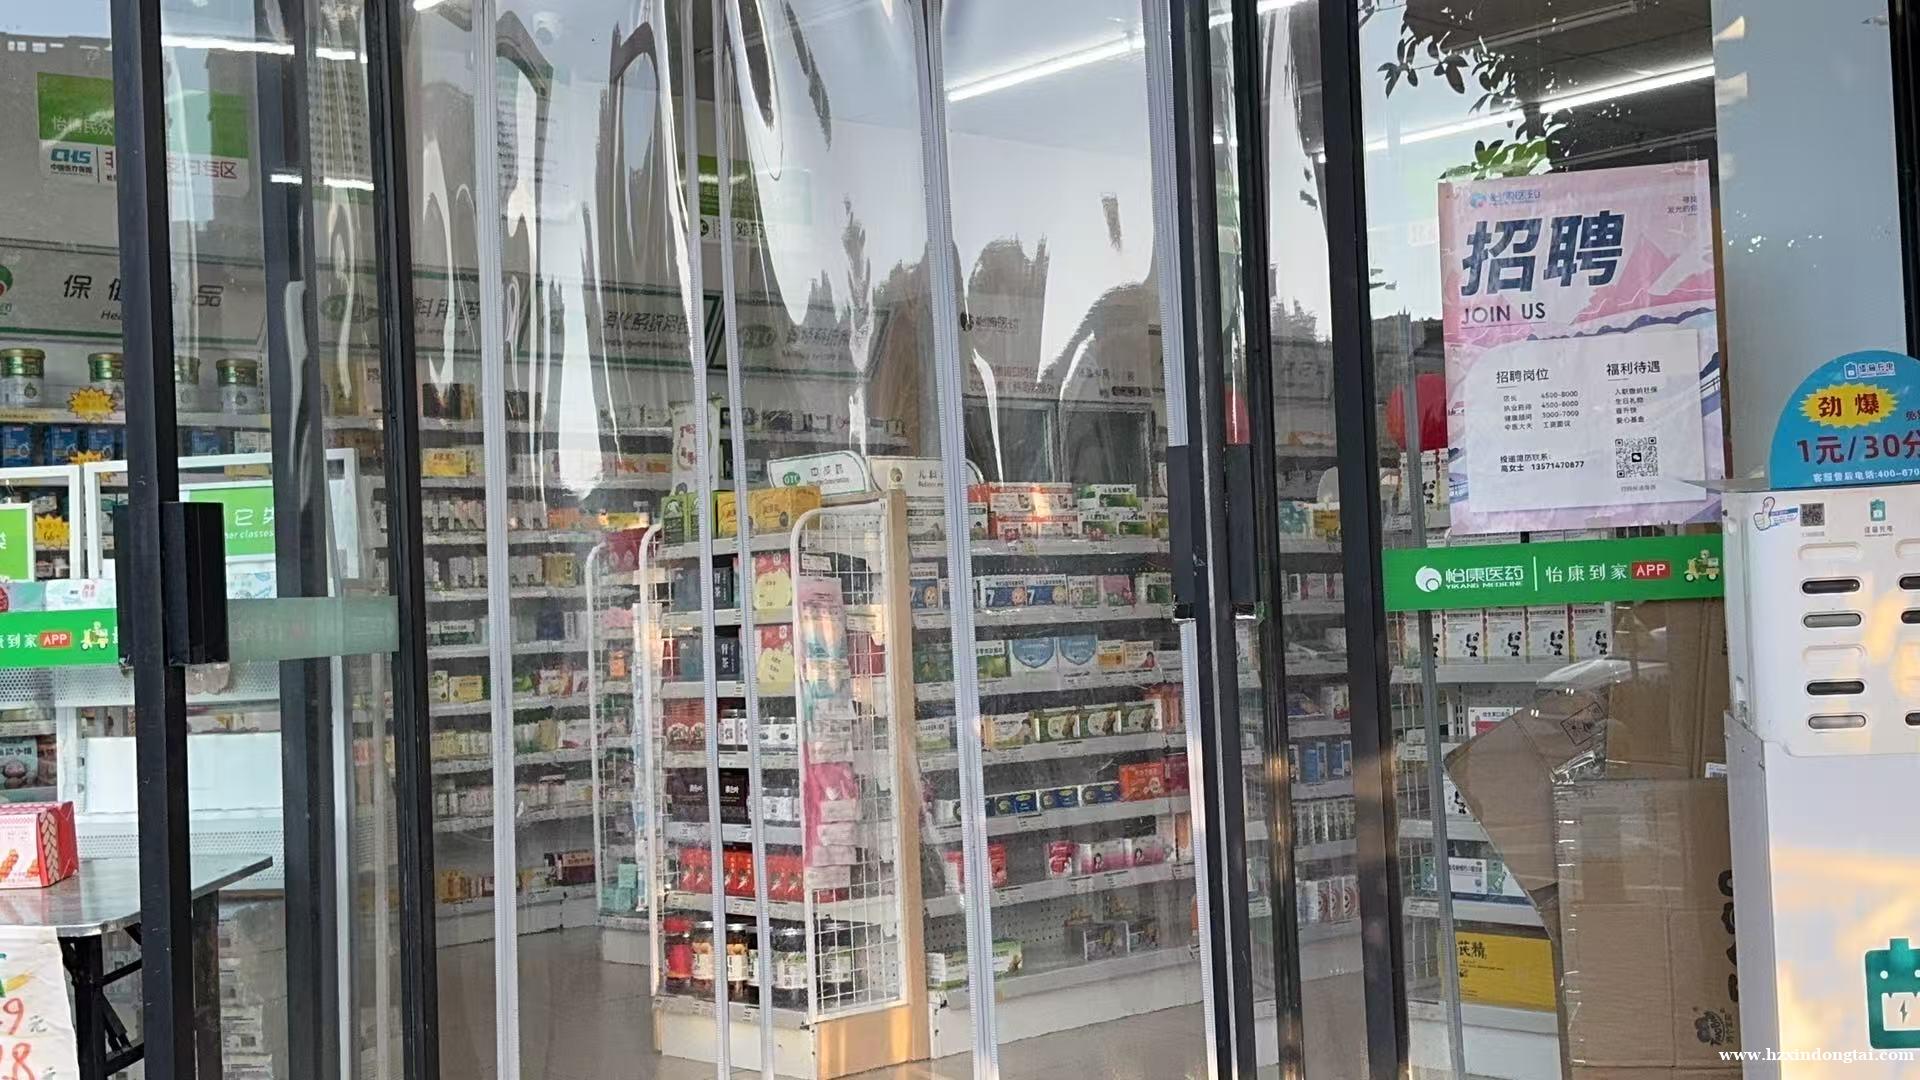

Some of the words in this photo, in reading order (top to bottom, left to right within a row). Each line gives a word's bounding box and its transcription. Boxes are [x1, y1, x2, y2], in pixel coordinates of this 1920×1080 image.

[1461, 210, 1625, 297] 招聘
[1461, 304, 1511, 325] JOIN
[1522, 302, 1546, 320] US
[1496, 367, 1550, 385] 招聘岗位
[1605, 360, 1661, 377] 福利待遇
[1817, 392, 1880, 418] 劲爆
[1445, 564, 1524, 584] 怡康医药
[1545, 563, 1628, 583] 怡康到家
[1636, 563, 1666, 577] APP
[43, 633, 69, 646] APP
